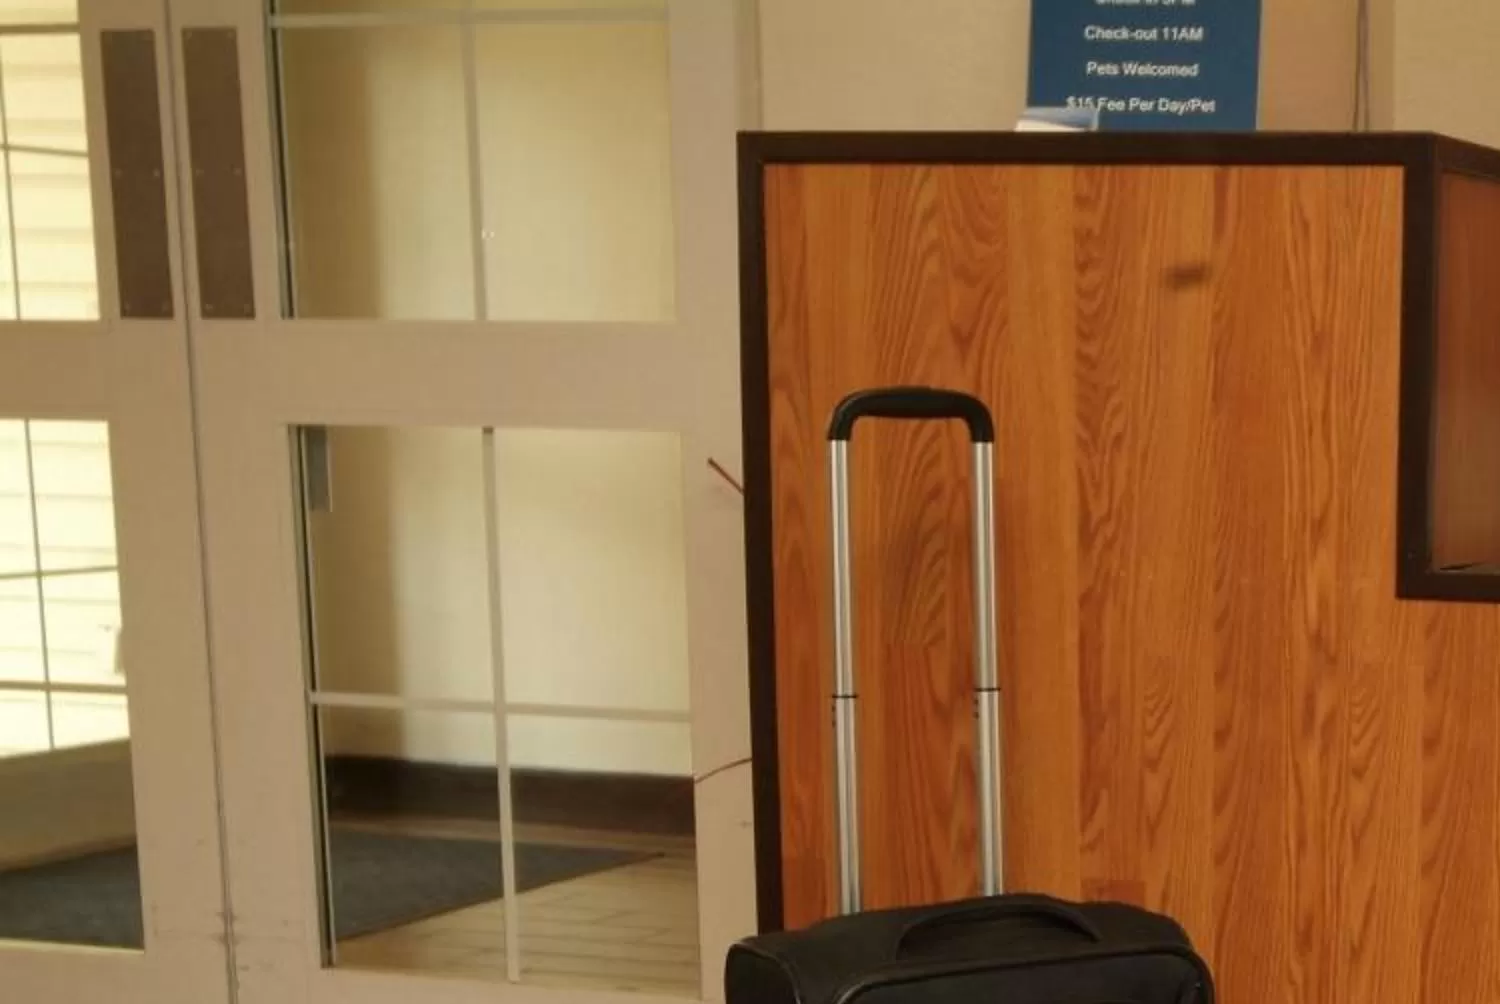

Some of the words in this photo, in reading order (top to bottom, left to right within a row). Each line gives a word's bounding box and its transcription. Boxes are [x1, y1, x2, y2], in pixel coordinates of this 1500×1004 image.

[1084, 24, 1157, 40] Check-out
[1162, 26, 1204, 40] 11AM
[1086, 61, 1119, 75] Pets
[1121, 62, 1199, 77] Welcomed
[1066, 96, 1094, 109] $15
[1097, 97, 1126, 111] Fee
[1129, 98, 1154, 112] Per
[1158, 98, 1216, 116] Day/Pet
